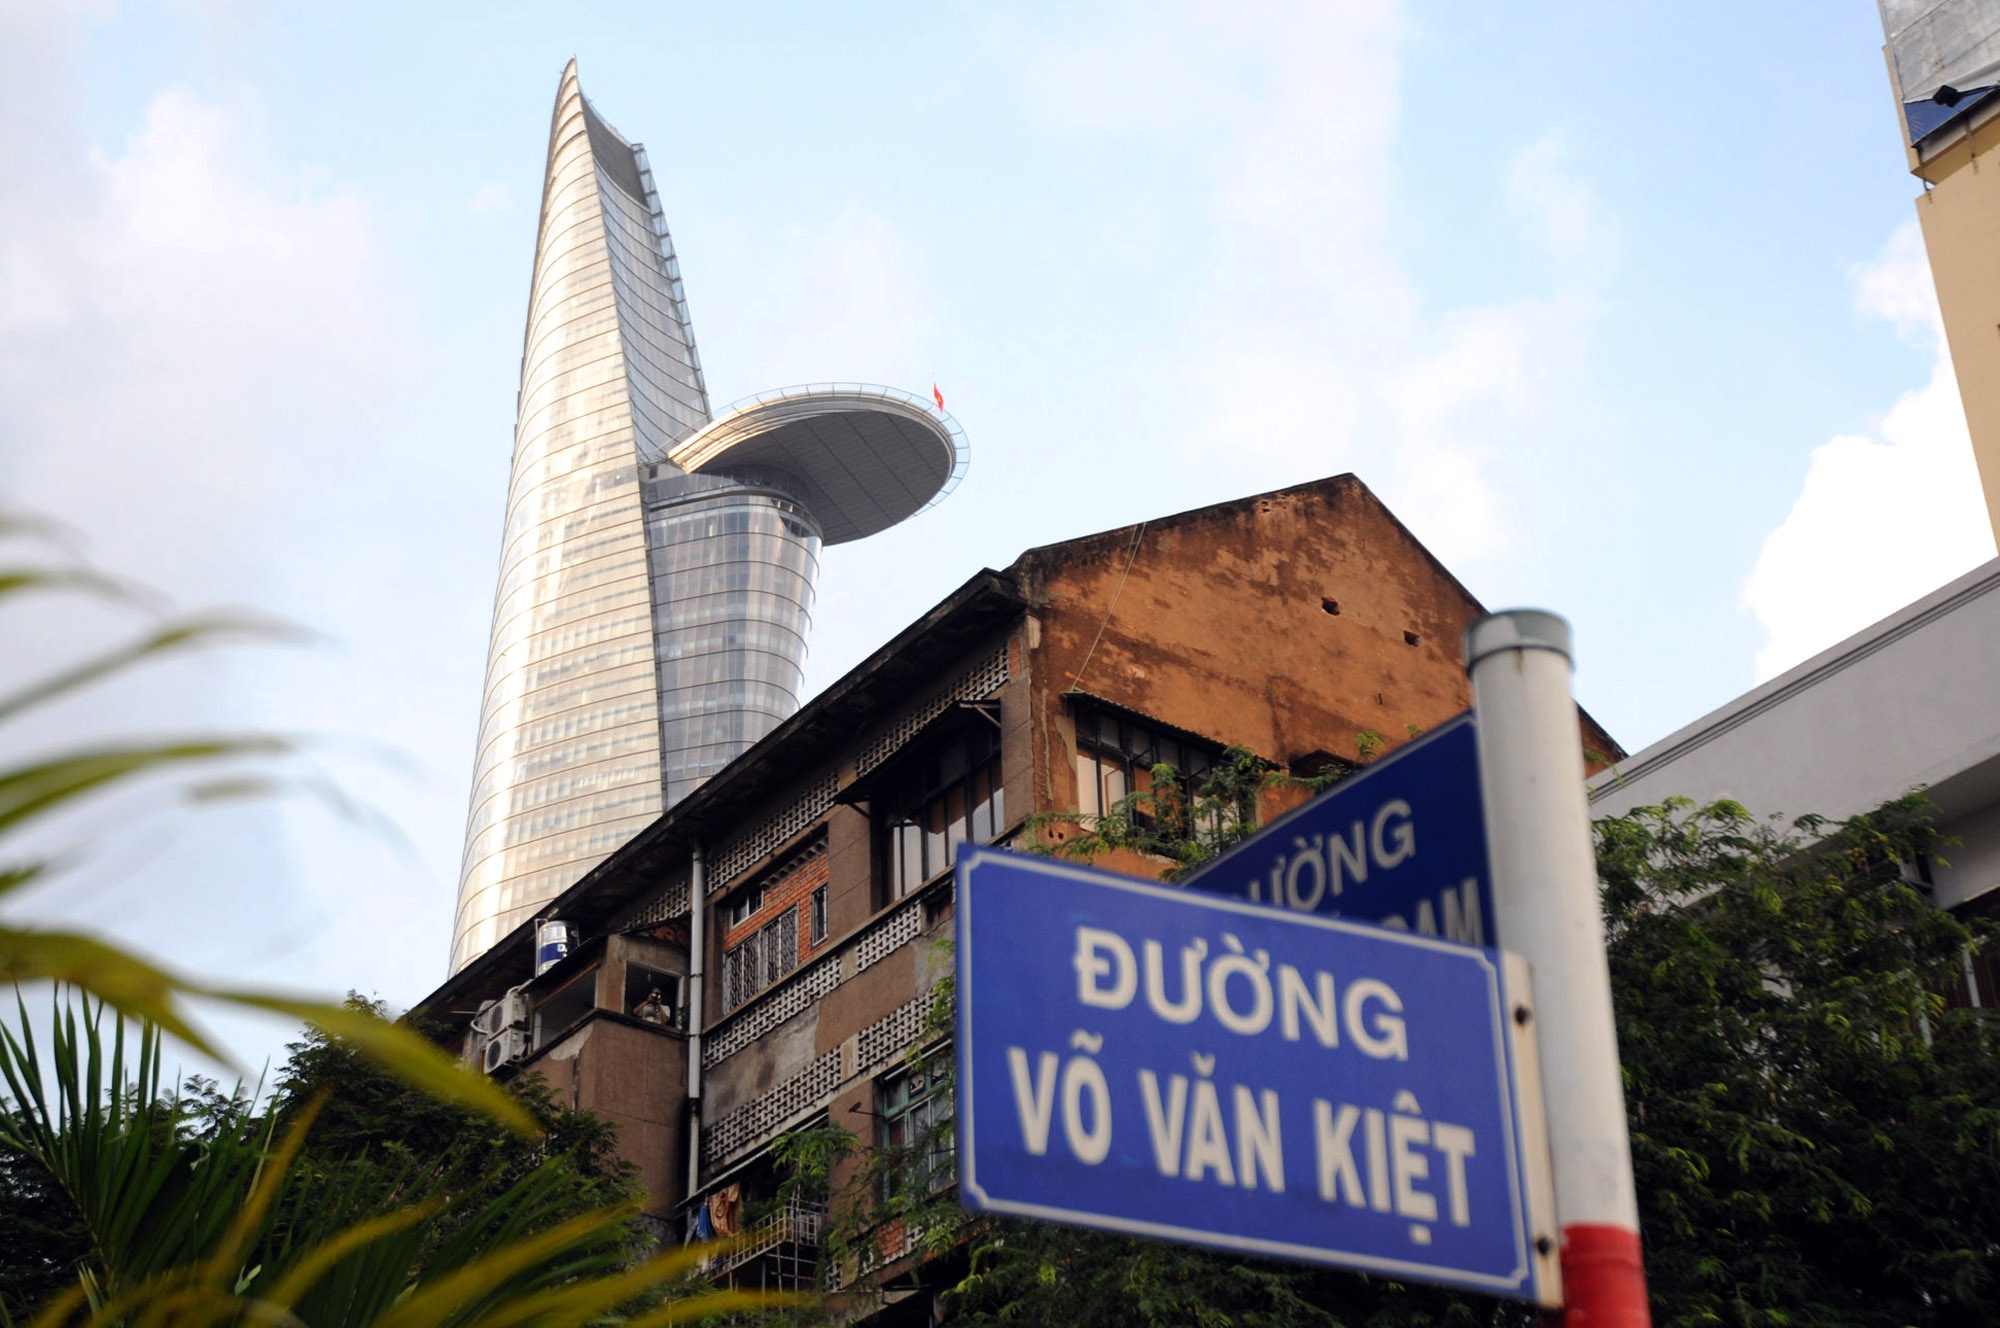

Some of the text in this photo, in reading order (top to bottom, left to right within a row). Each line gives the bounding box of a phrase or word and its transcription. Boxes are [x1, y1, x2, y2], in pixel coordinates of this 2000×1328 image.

[1233, 799, 1415, 911] ƯỜNG
[1381, 877, 1485, 946] AM
[1073, 926, 1409, 1062] ĐƯỜNG
[1007, 1029, 1476, 1245] VÕ VĂN KIỆT
